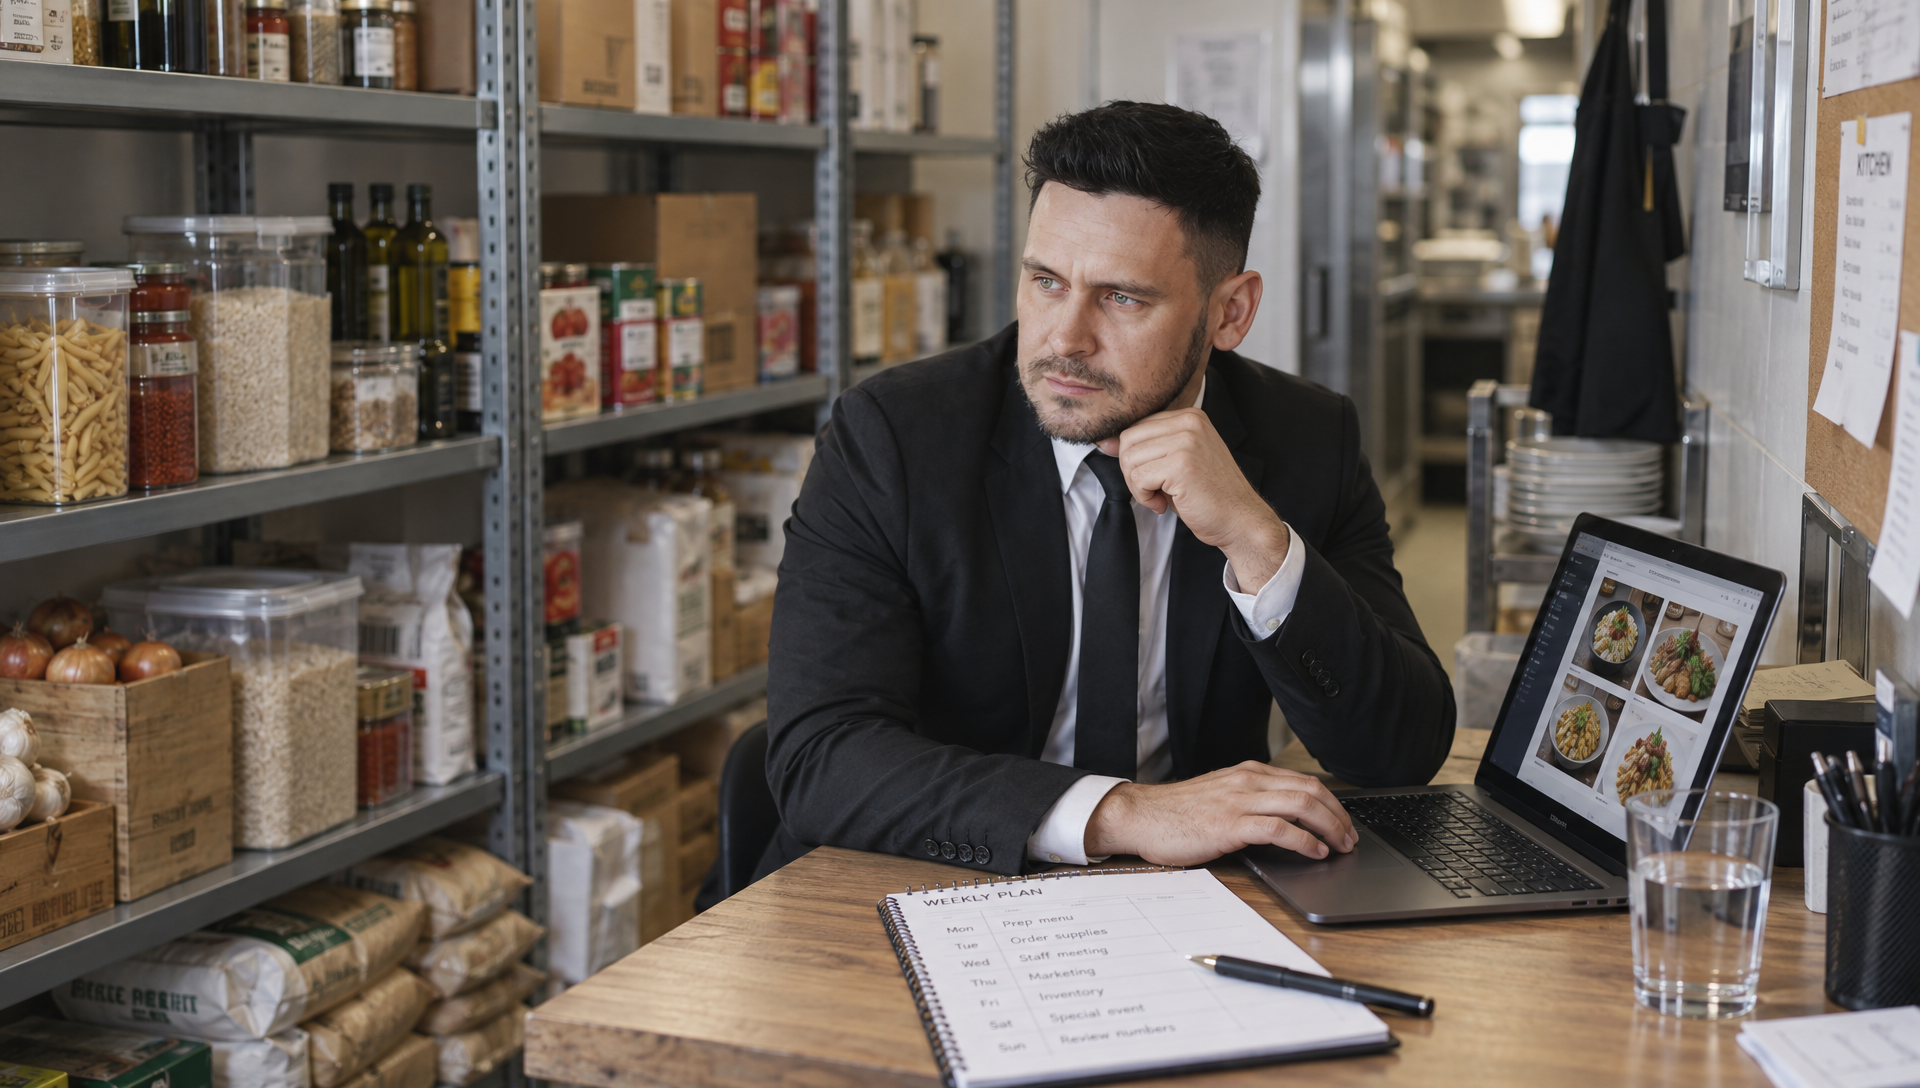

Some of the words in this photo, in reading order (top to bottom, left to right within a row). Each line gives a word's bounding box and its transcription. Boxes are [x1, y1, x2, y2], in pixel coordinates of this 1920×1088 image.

[1857, 151, 1893, 176] KITCHEN
[923, 893, 991, 907] WEEKLY
[997, 888, 1043, 899] PLAN
[1002, 919, 1033, 928] Prep
[1038, 914, 1075, 924] menu
[946, 925, 974, 934] Mon
[1010, 934, 1049, 945] Order
[1054, 927, 1108, 940] supplies
[954, 941, 979, 950] Tue
[1019, 952, 1051, 963] Staff
[1057, 946, 1109, 959] meeting
[961, 958, 991, 968] Wed
[1028, 967, 1096, 981] Marketing
[970, 977, 997, 987] Thu
[1039, 987, 1104, 1001] Inventory
[980, 998, 1000, 1008] Fri
[1050, 1008, 1101, 1024] Special
[1107, 1004, 1146, 1016] event
[989, 1019, 1014, 1030] Sat
[1059, 1032, 1110, 1045] Review
[1116, 1024, 1177, 1038] numbers
[998, 1042, 1027, 1053] Sun
